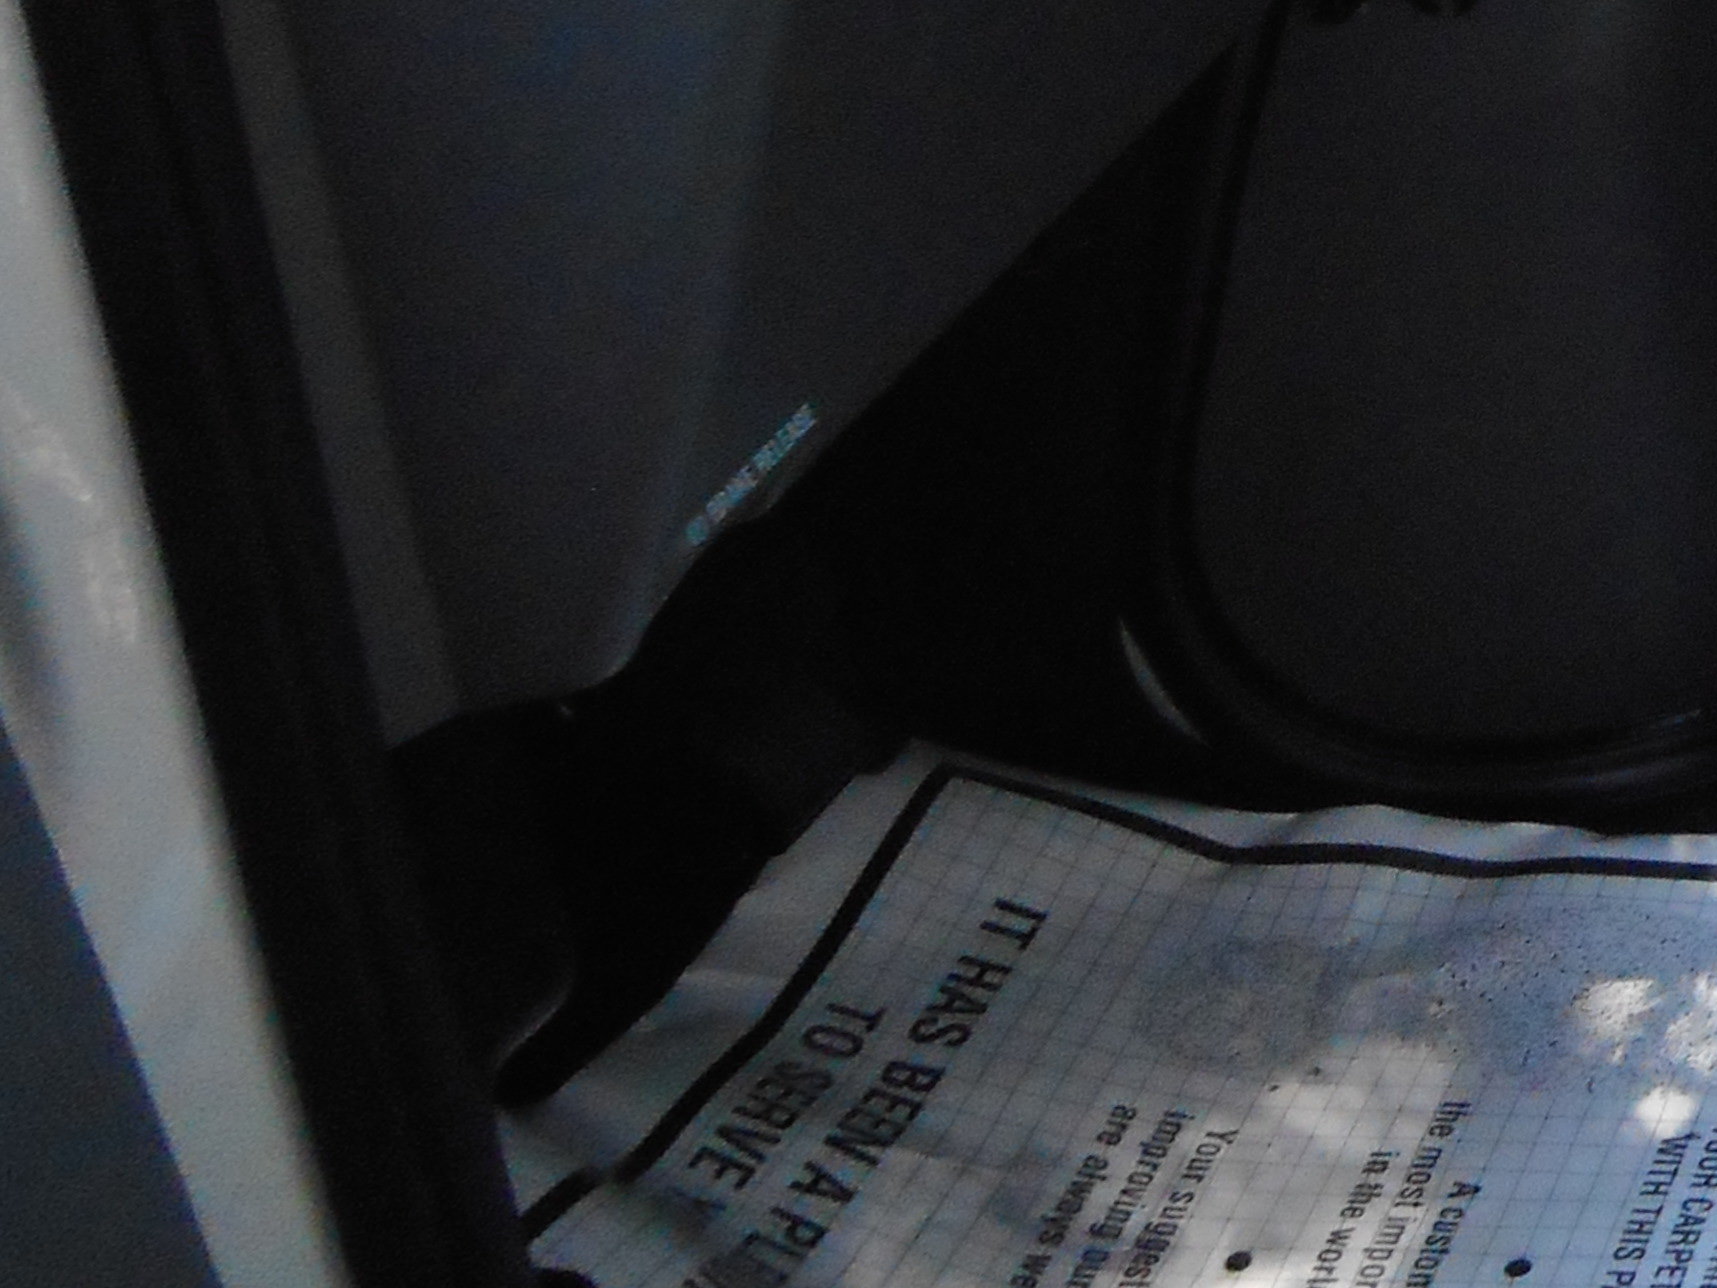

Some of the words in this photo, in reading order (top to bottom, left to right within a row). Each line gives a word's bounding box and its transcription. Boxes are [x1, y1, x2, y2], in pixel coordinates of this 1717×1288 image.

[980, 897, 1050, 952] IT
[801, 1001, 889, 1058] TO
[909, 955, 1013, 1048] HAS
[688, 1061, 834, 1191] SERVE
[823, 1060, 946, 1168] BEEN
[1095, 1103, 1138, 1147] are
[1429, 1101, 1471, 1138] the
[788, 1160, 859, 1204] A
[1088, 1108, 1195, 1241] improving
[1181, 1128, 1240, 1184] Your
[1361, 1150, 1400, 1175] in
[1394, 1146, 1442, 1208] most
[1638, 1132, 1697, 1197] WITH
[1038, 1153, 1110, 1248] always
[1339, 1183, 1383, 1219] the
[1447, 1180, 1481, 1200] A
[1305, 1227, 1355, 1288] worl
[1612, 1205, 1664, 1262] THIS
